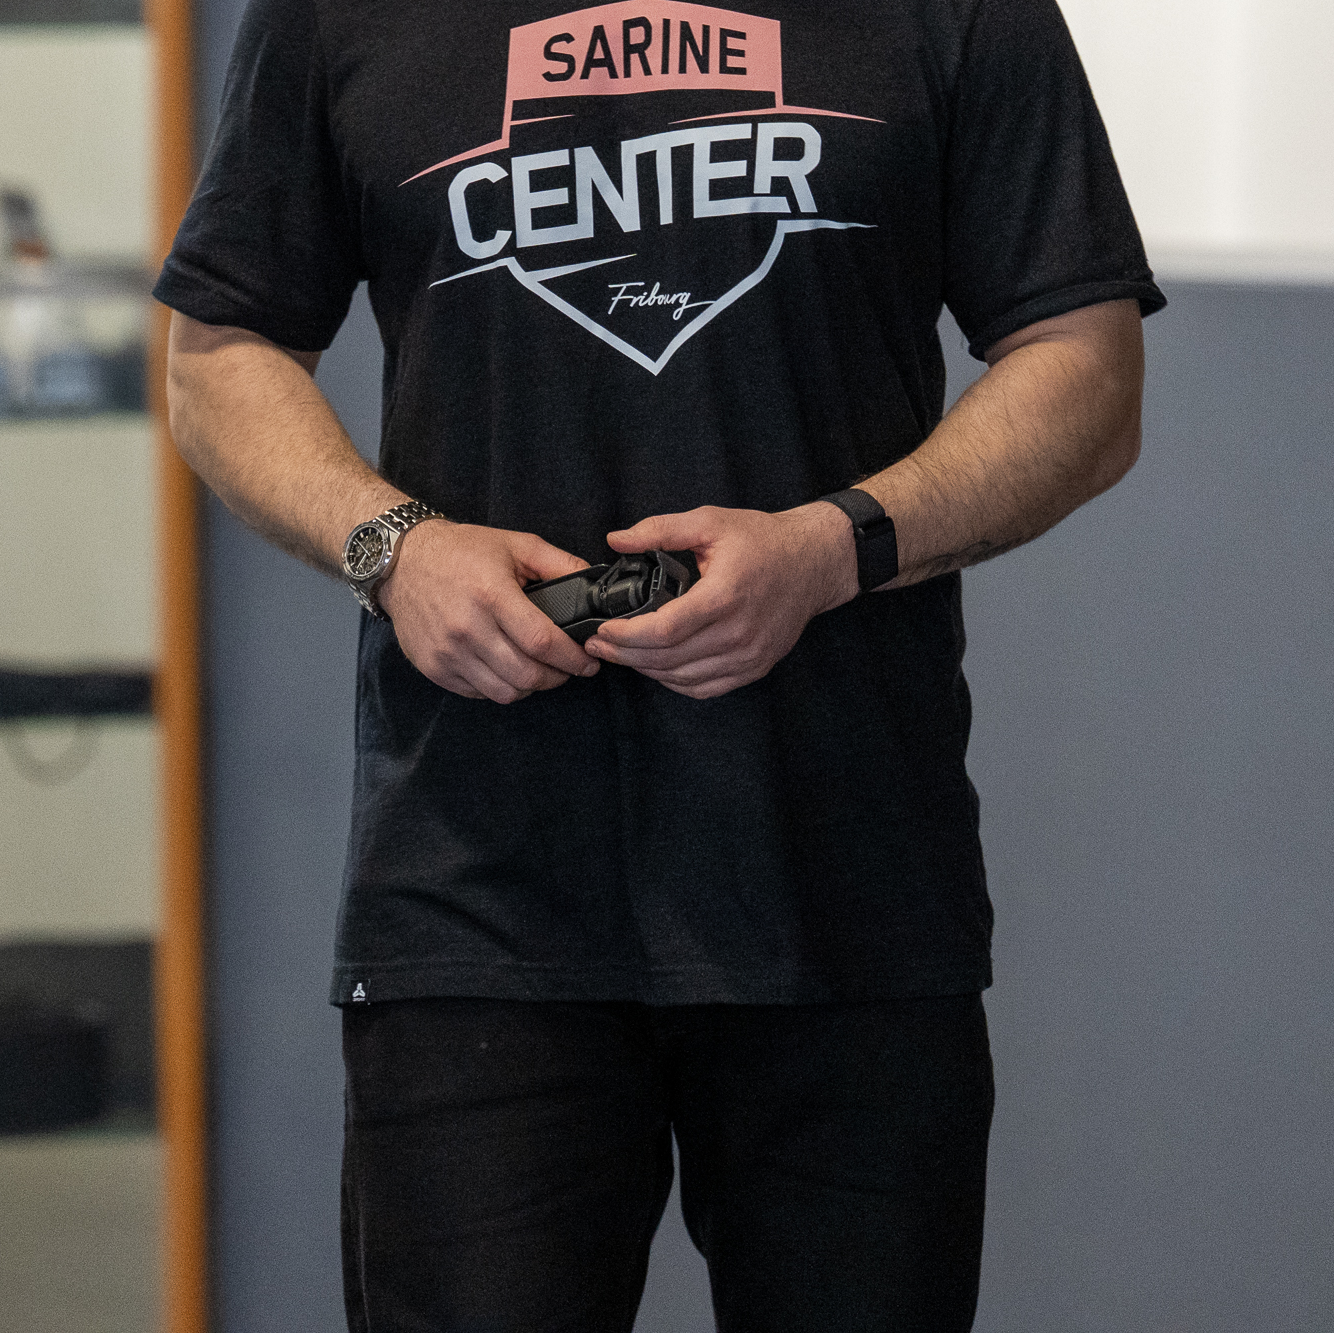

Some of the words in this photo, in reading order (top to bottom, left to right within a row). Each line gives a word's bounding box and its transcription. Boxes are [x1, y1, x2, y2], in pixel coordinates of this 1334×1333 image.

[543, 16, 747, 82] SARINE
[448, 122, 822, 259] CENTER
[608, 281, 716, 320] Fribourg
